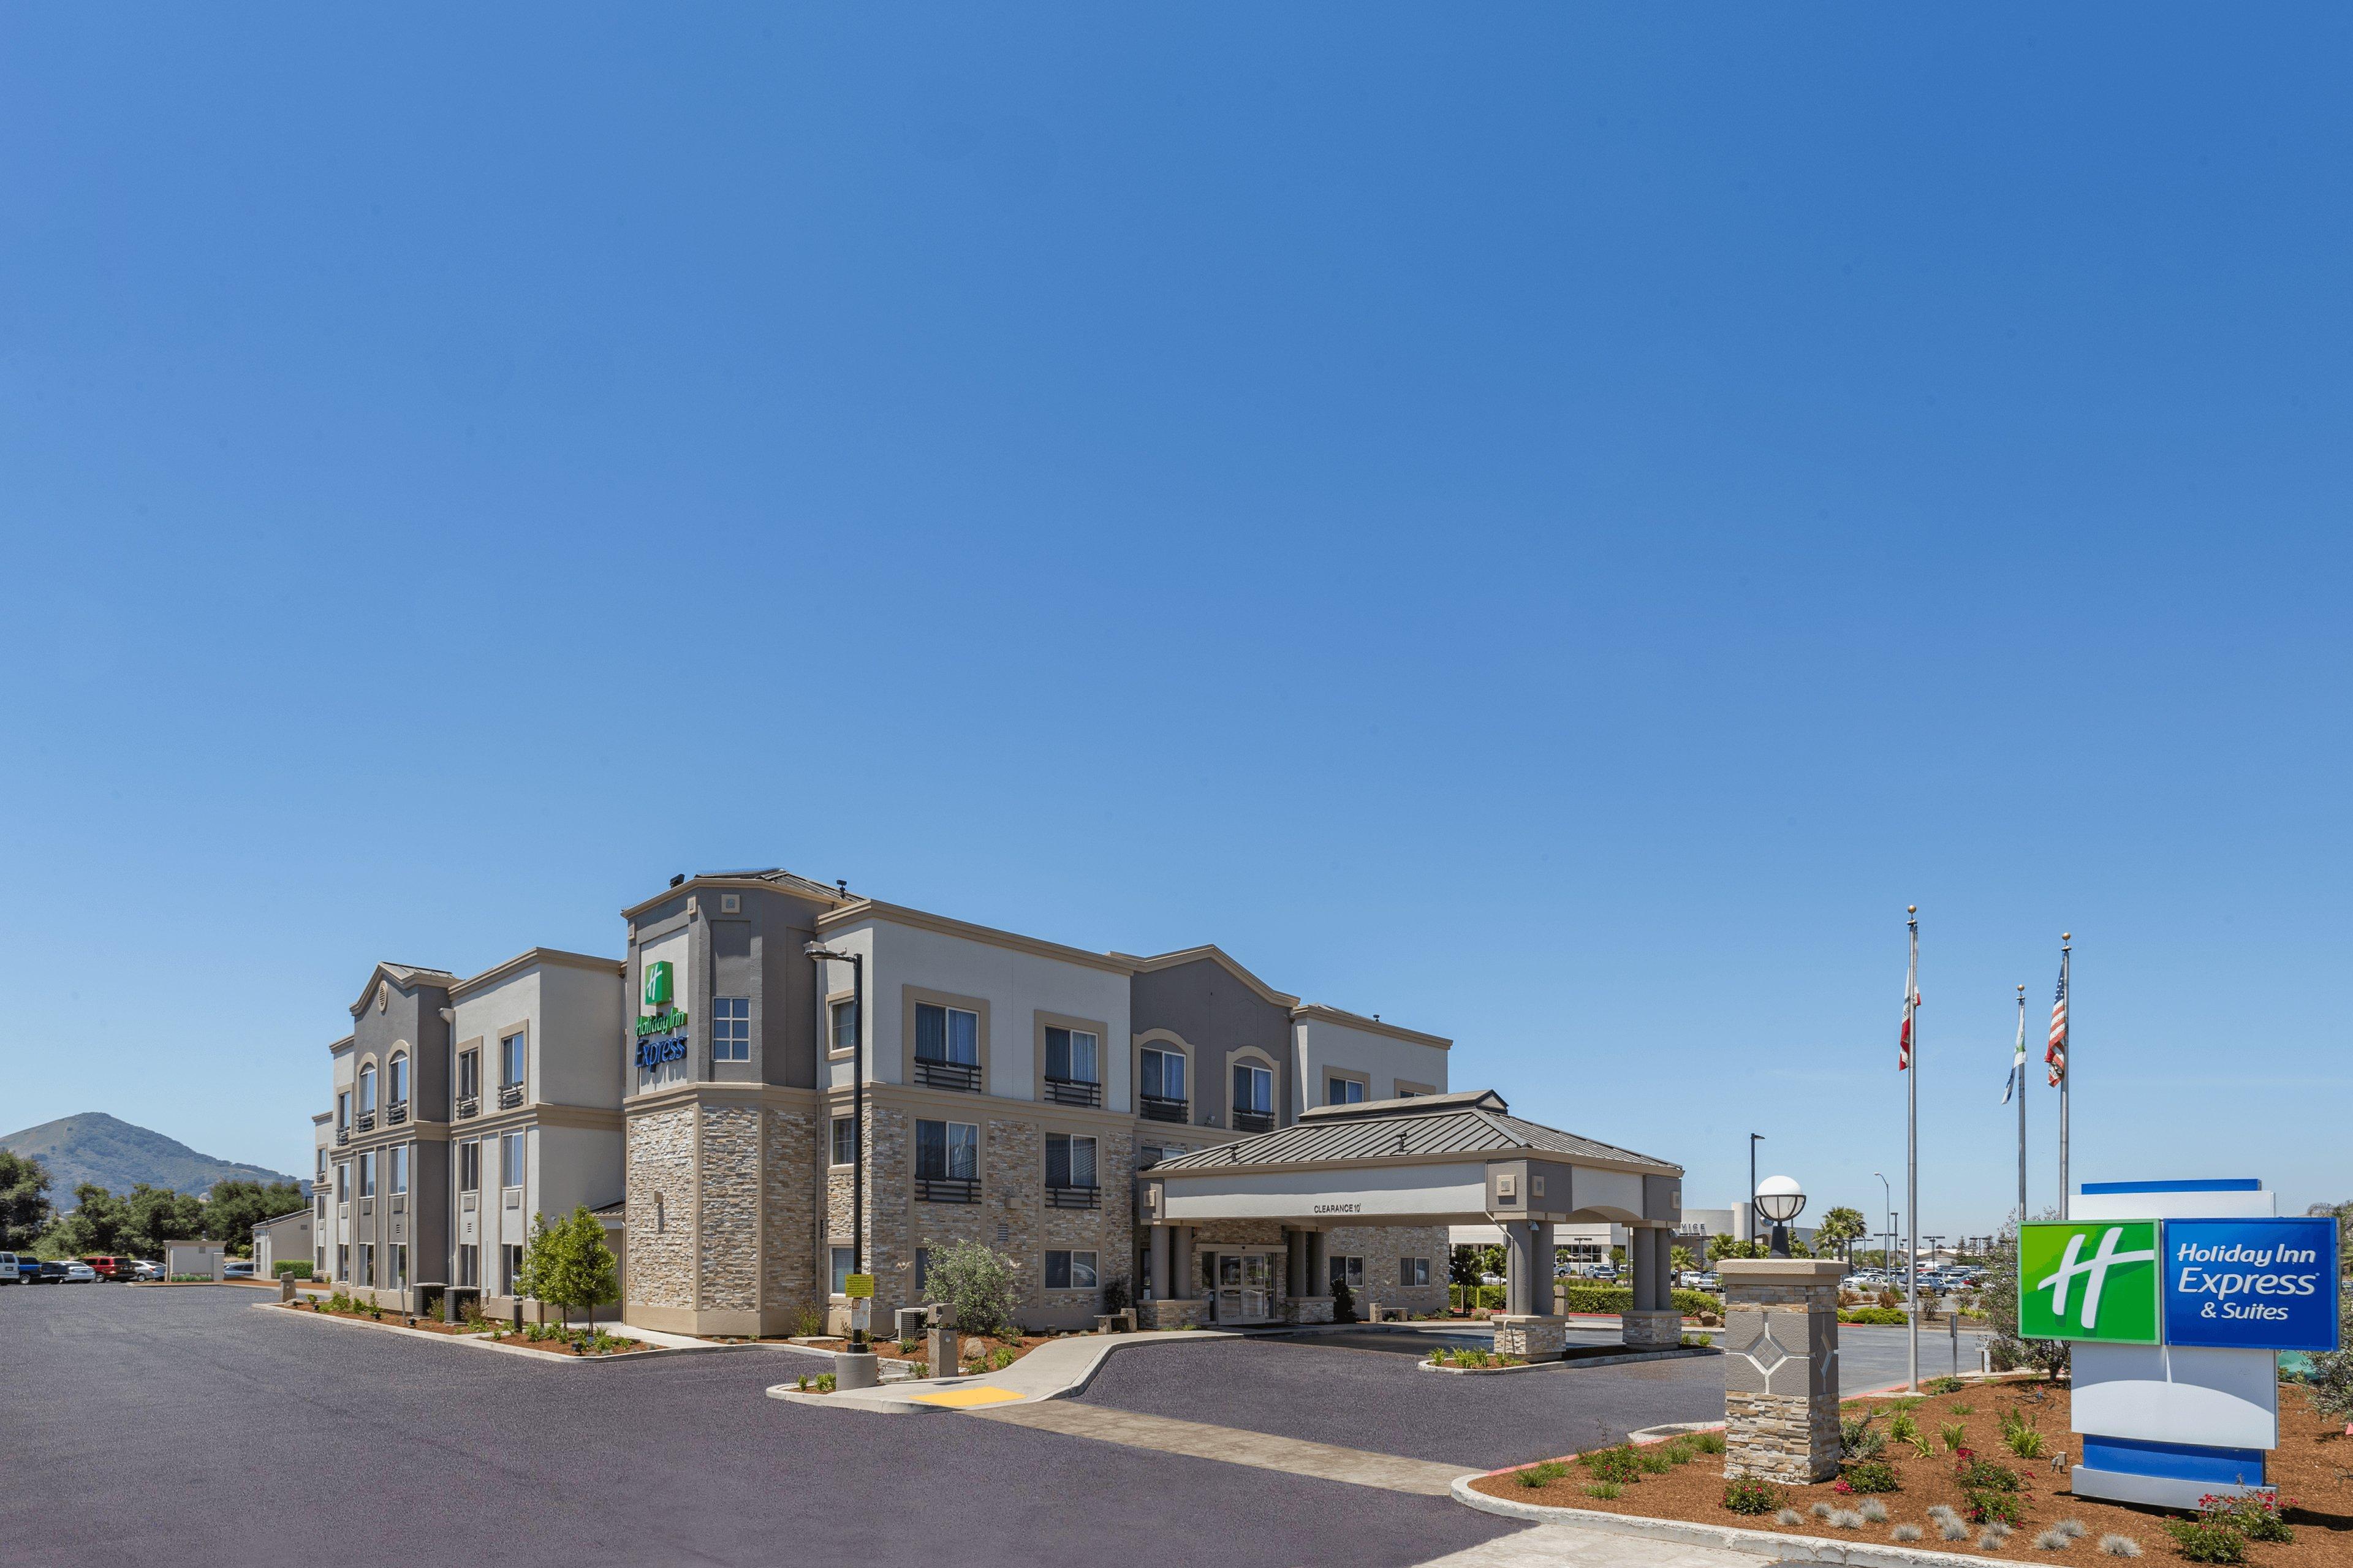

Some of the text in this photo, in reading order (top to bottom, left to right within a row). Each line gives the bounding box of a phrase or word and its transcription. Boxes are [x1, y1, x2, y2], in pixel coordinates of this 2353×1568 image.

[635, 1007, 688, 1037] Holiday Inn
[634, 1036, 688, 1073] Express
[1314, 1204, 1353, 1213] CLEARANCE
[2177, 1243, 2316, 1267] Holiday Inn
[2178, 1267, 2317, 1300] Express
[2200, 1301, 2289, 1320] & Suites
